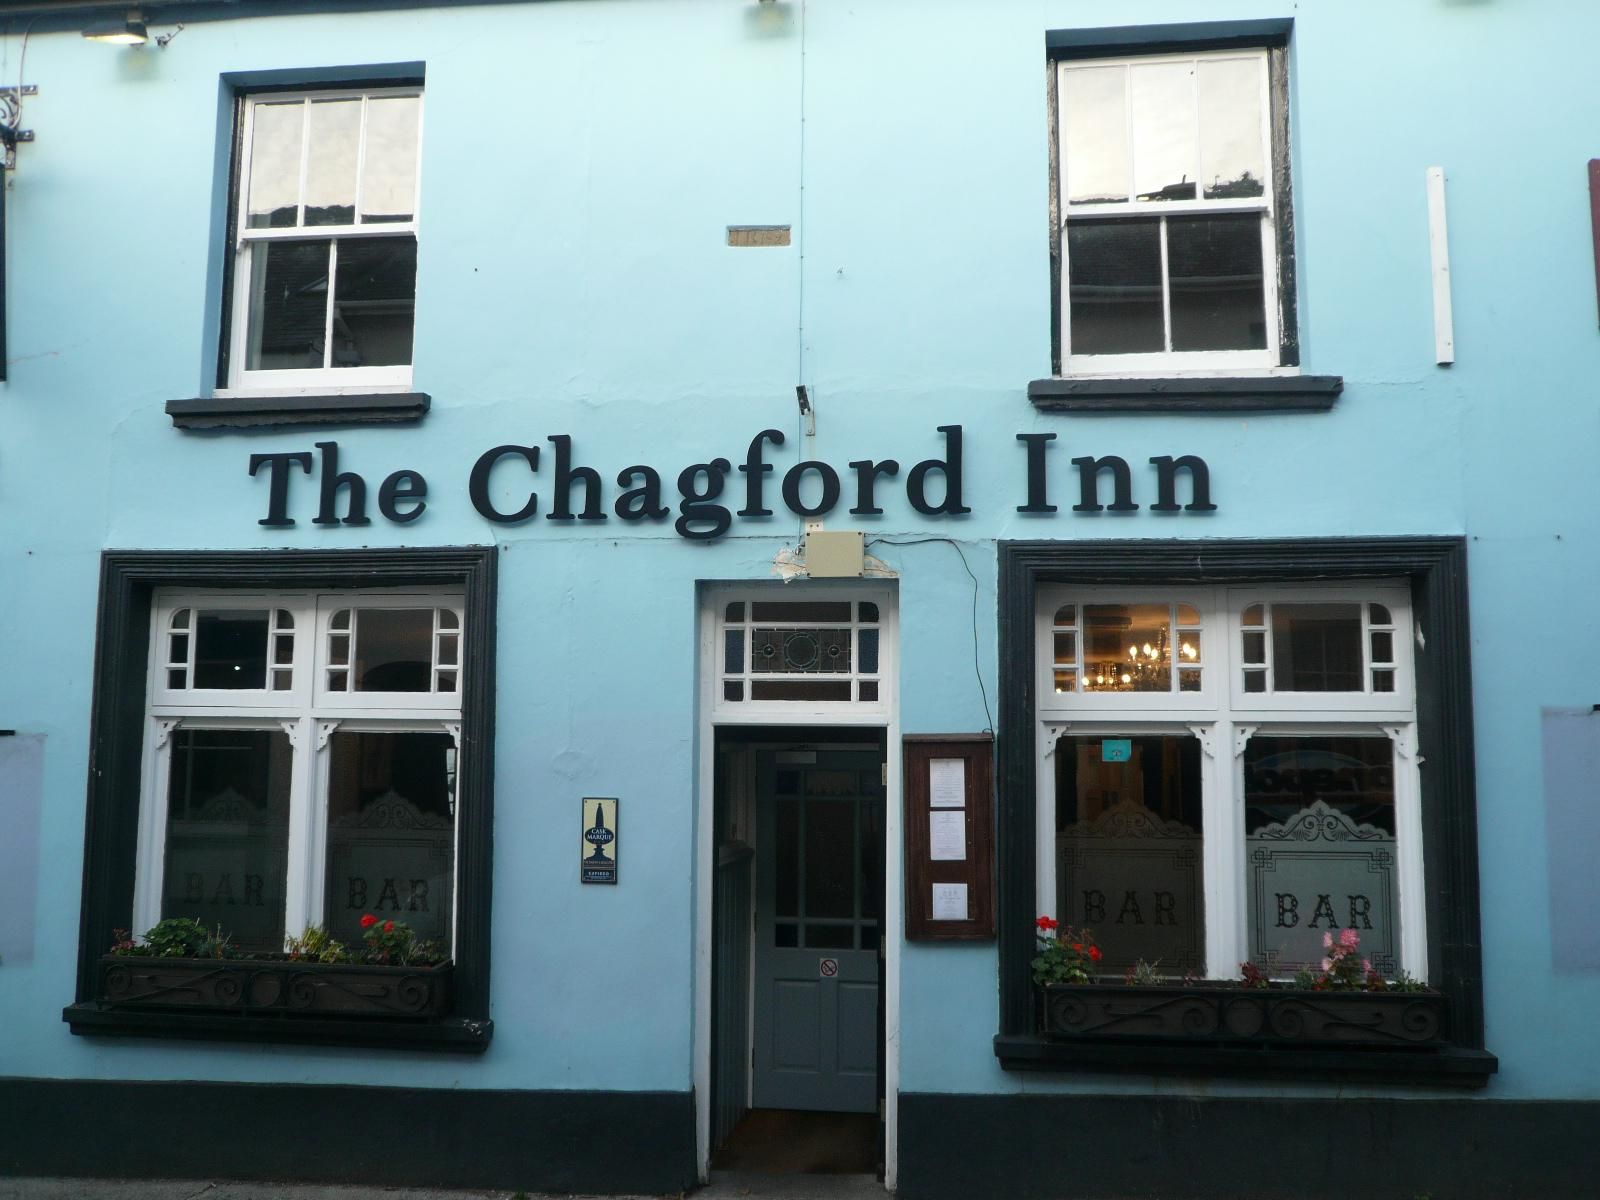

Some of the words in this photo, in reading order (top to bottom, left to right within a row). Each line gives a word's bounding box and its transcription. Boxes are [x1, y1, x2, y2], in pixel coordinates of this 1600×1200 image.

[249, 442, 427, 528] The
[469, 425, 971, 539] Chagford
[1016, 433, 1217, 514] Inn
[186, 873, 265, 906] BAR
[347, 877, 429, 912] BAR
[1081, 890, 1179, 926] BAR
[1276, 894, 1374, 929] BAR
